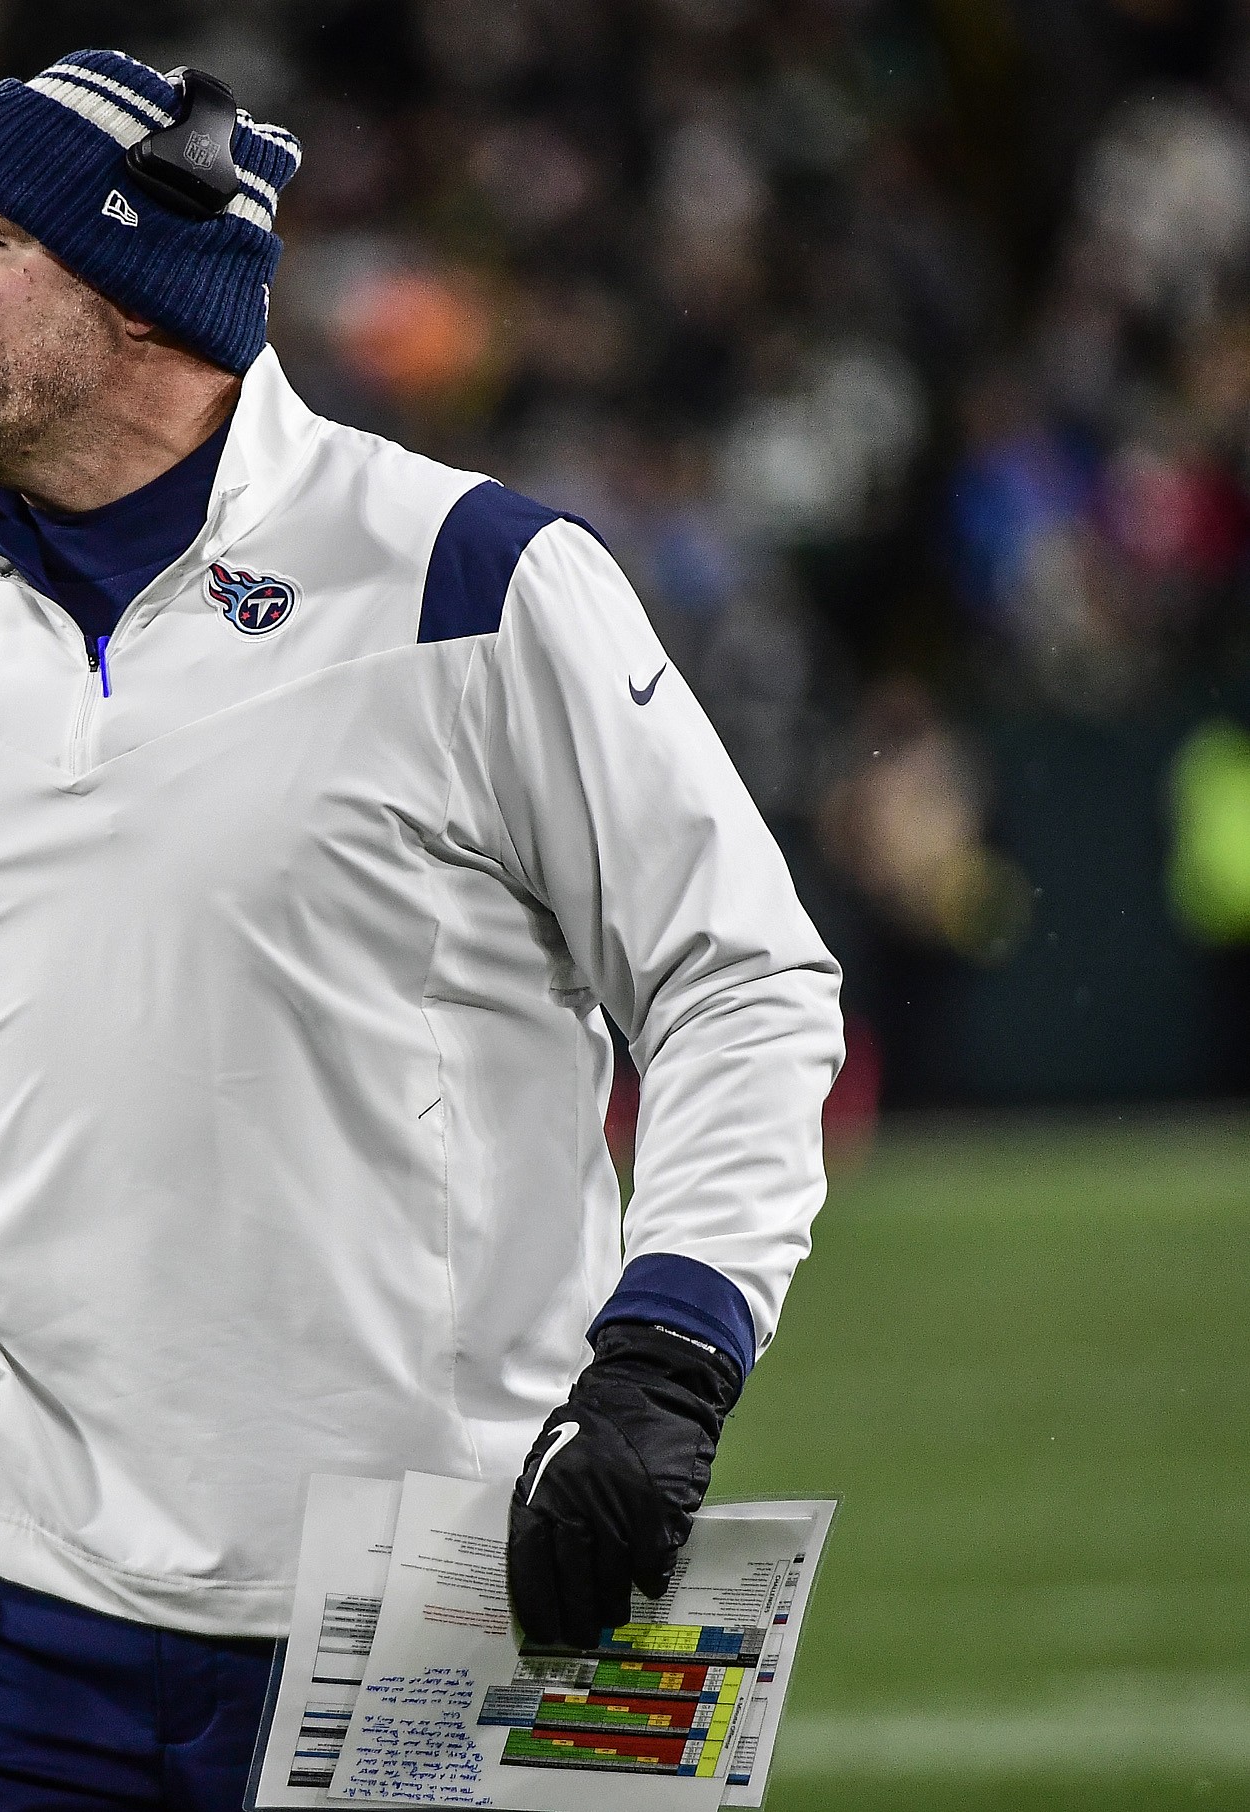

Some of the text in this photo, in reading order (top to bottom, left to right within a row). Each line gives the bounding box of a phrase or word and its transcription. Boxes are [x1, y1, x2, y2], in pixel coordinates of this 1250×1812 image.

[187, 141, 214, 167] NFL
[247, 597, 285, 628] T
[763, 1574, 781, 1613] CHALLENGES
